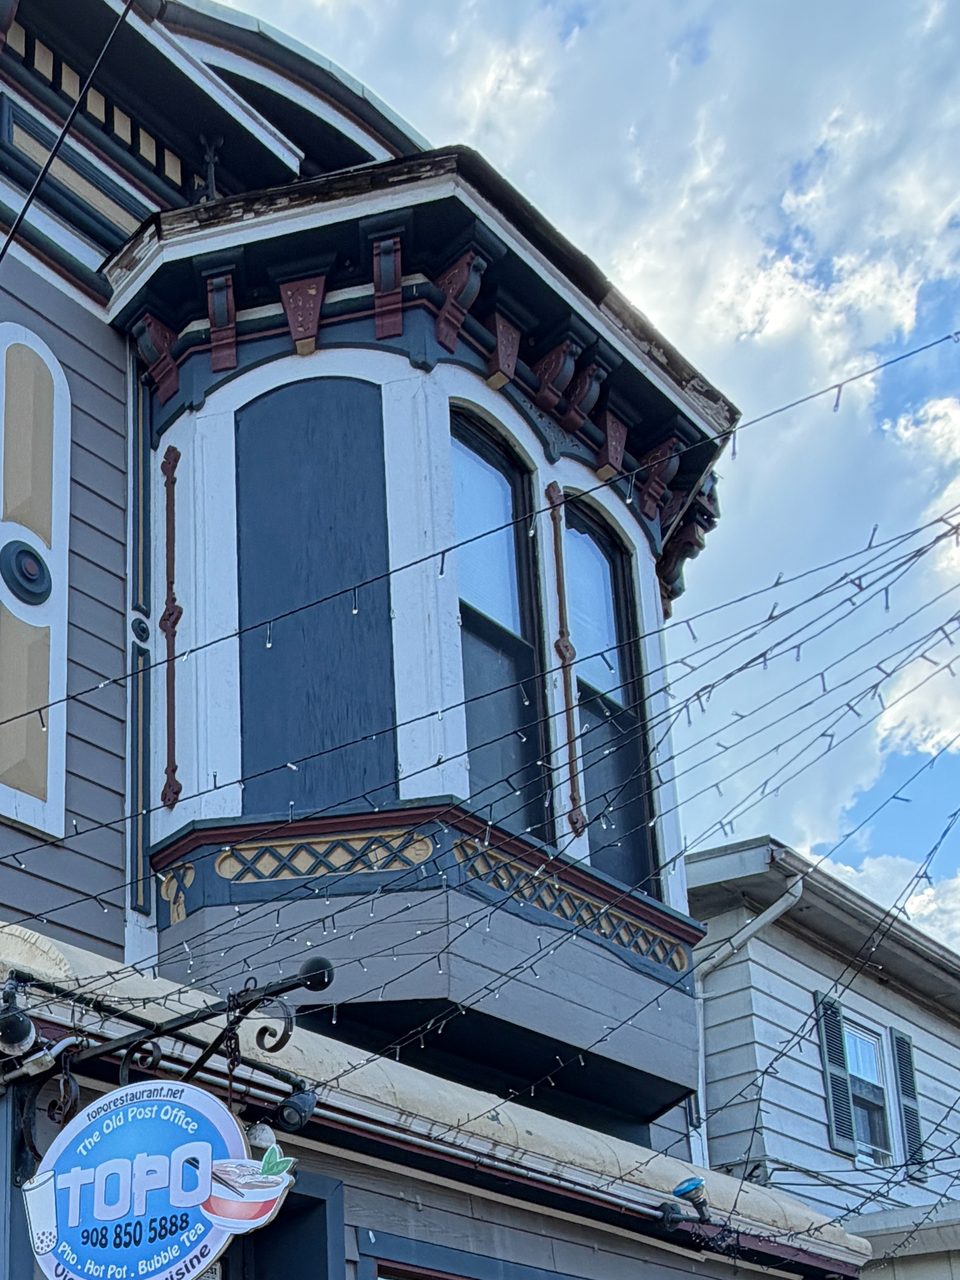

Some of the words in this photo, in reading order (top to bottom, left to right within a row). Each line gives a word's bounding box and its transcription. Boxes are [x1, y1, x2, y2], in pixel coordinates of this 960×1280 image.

[76, 1129, 101, 1157] The
[102, 1111, 124, 1135] Old
[128, 1104, 157, 1122] Post
[159, 1105, 199, 1135] Office
[86, 1086, 185, 1122] toporestaurant.net
[57, 1141, 213, 1228] TOPO
[58, 1241, 77, 1264] Pho
[84, 1258, 105, 1278] Hot
[107, 1264, 126, 1279] Pot
[137, 1244, 181, 1275] Bubble
[180, 1222, 205, 1247] Tea
[81, 1225, 108, 1248] 908
[113, 1220, 142, 1248] 850
[148, 1212, 189, 1243] 5888
